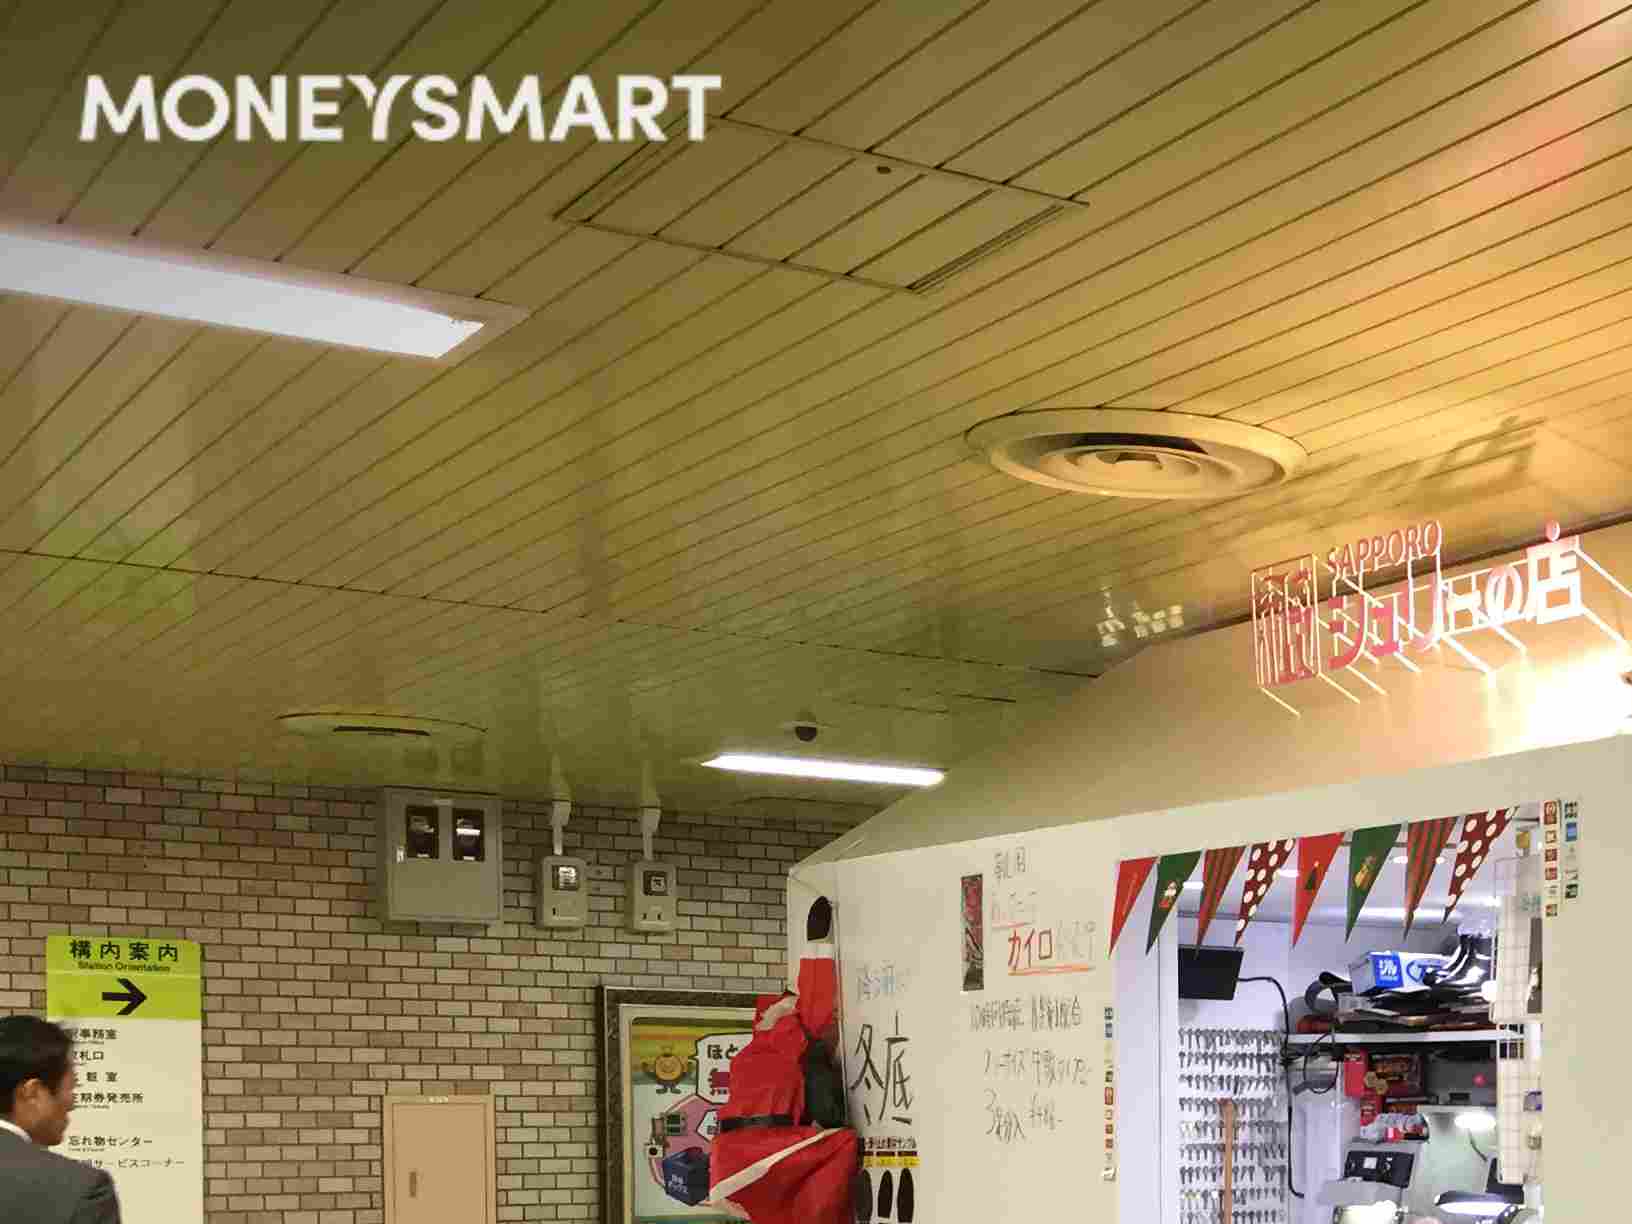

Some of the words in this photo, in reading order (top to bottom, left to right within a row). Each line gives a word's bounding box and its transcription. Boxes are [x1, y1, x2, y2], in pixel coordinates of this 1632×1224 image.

[1326, 520, 1442, 584] SAPPORO
[69, 939, 179, 962] 構内案内
